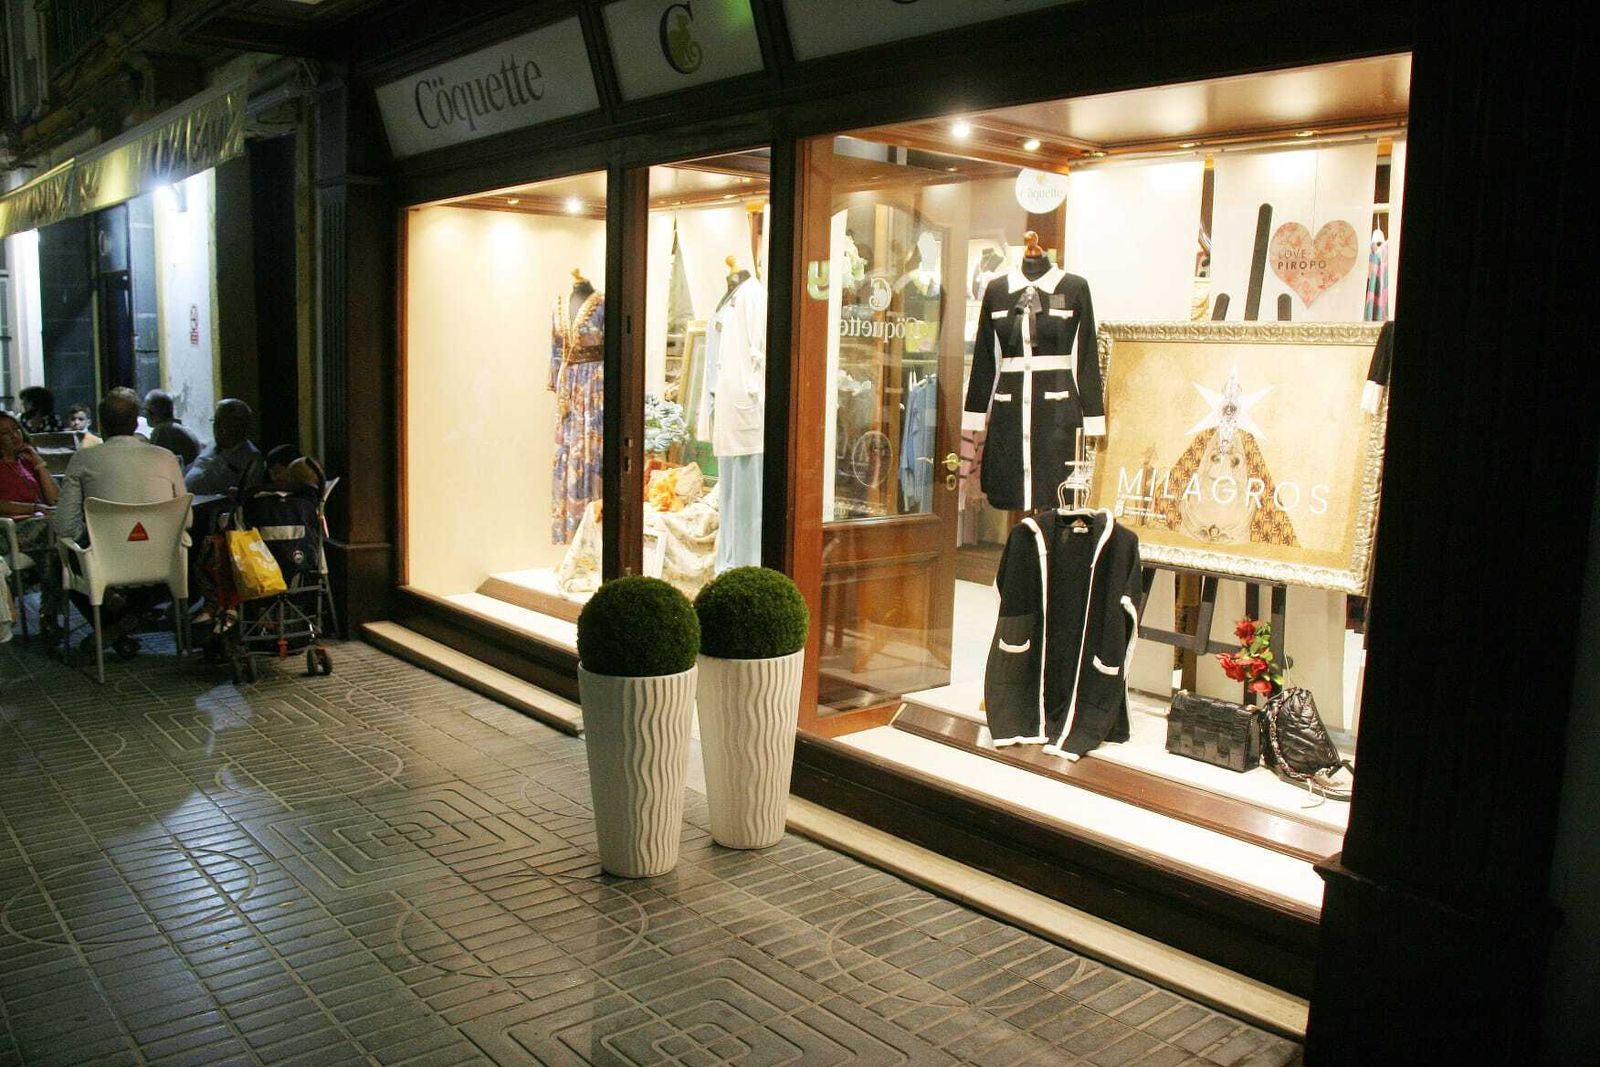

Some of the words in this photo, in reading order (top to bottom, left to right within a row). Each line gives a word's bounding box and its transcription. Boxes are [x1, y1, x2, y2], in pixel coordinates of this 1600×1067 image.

[415, 54, 545, 131] Cöquette
[1278, 260, 1327, 270] PIROPO
[1118, 466, 1328, 514] MILAGROS
